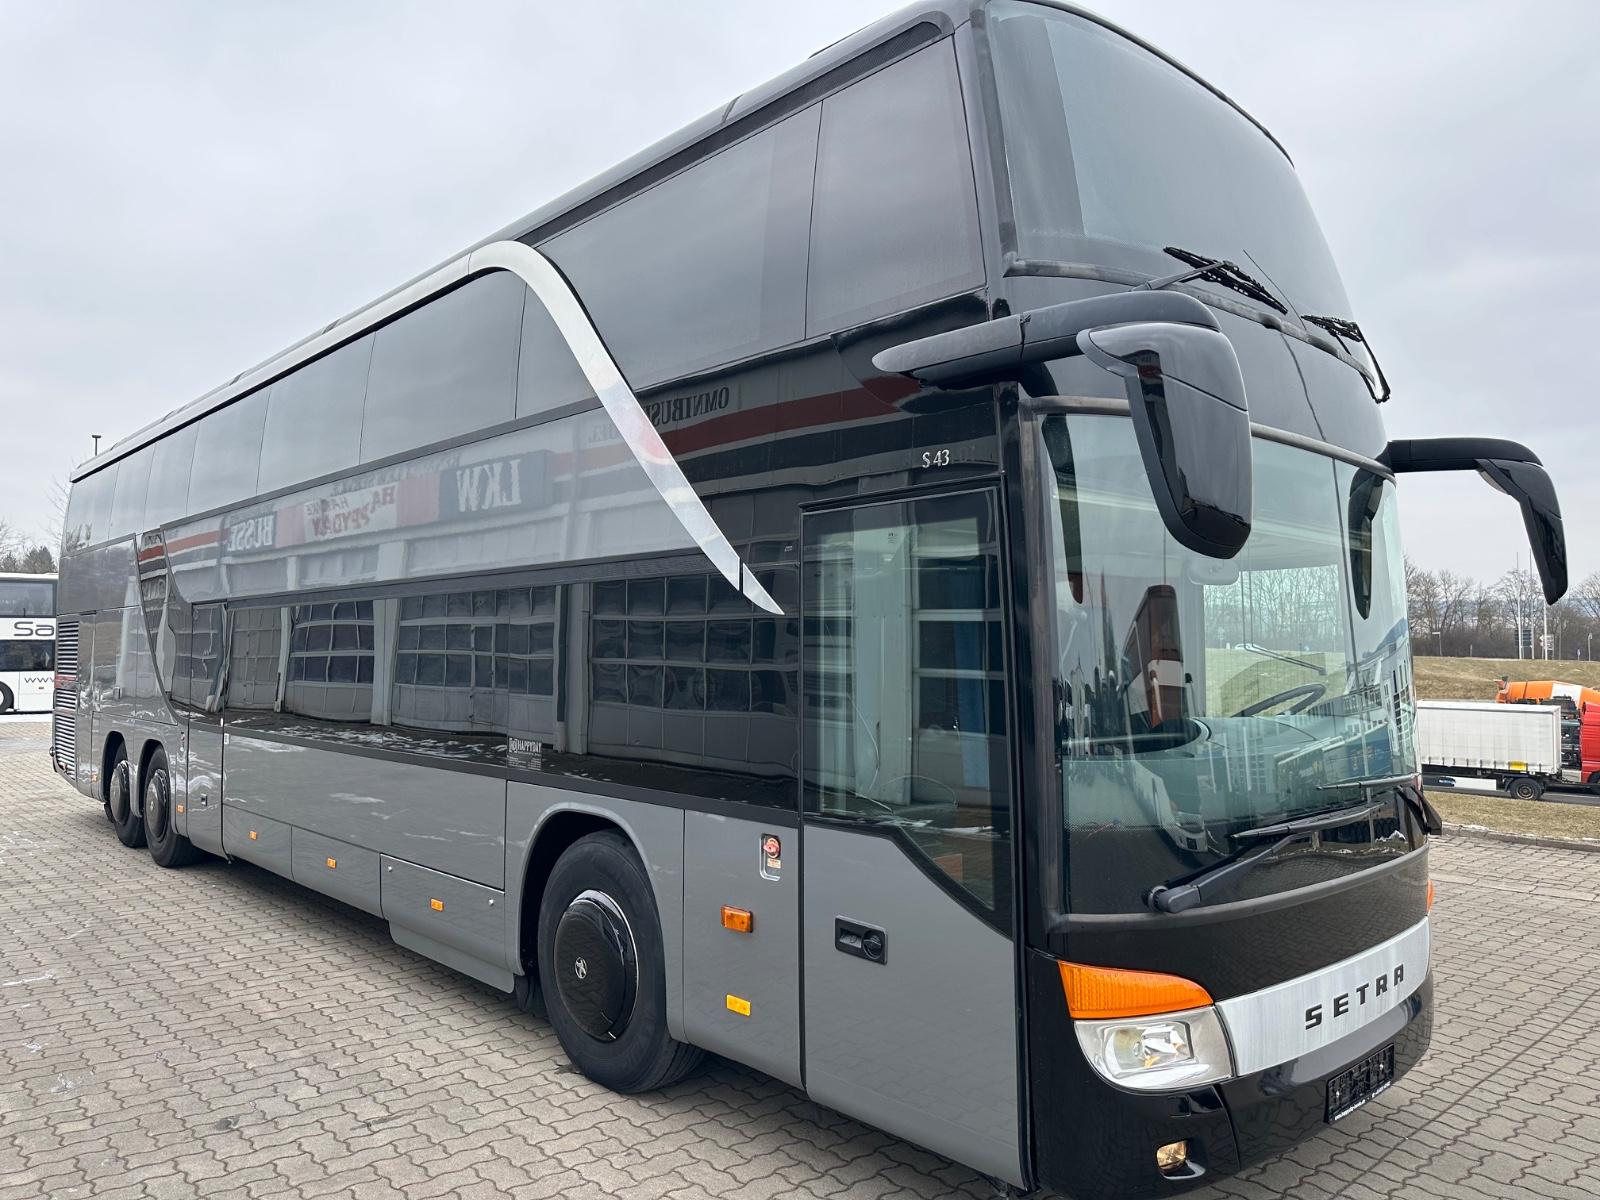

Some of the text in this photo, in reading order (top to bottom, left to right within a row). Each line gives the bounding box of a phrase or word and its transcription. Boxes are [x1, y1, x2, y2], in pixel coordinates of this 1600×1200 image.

[922, 449, 950, 469] S 43
[13, 621, 54, 636] Sa
[1305, 963, 1404, 1030] SETRA
